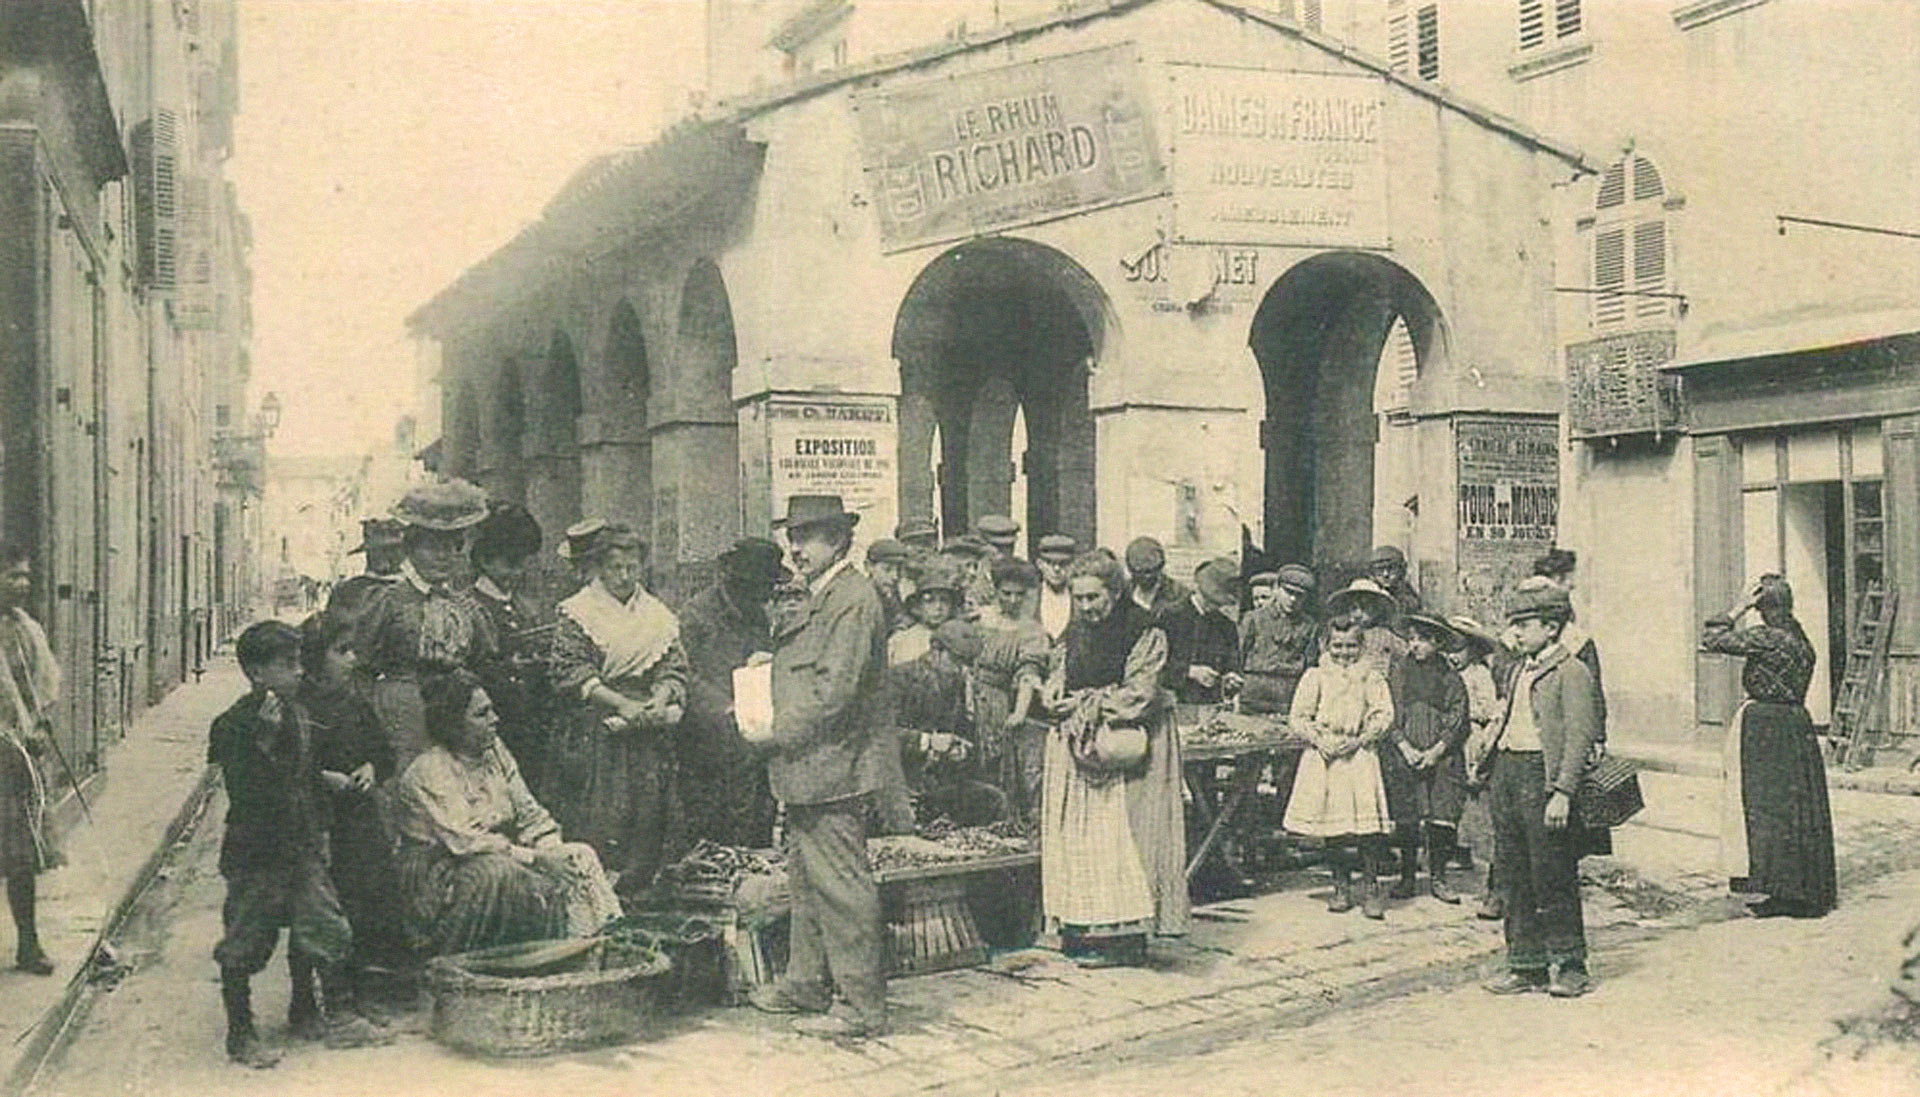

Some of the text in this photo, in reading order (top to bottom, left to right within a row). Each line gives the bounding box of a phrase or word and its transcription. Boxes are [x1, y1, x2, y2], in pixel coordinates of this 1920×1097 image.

[954, 94, 1062, 141] LE RHUM
[932, 126, 1097, 200] RICHARD
[795, 438, 876, 455] EXPOSITION
[1461, 484, 1495, 525] TOUR
[1511, 485, 1557, 526] MONDE
[1466, 526, 1484, 539] EN
